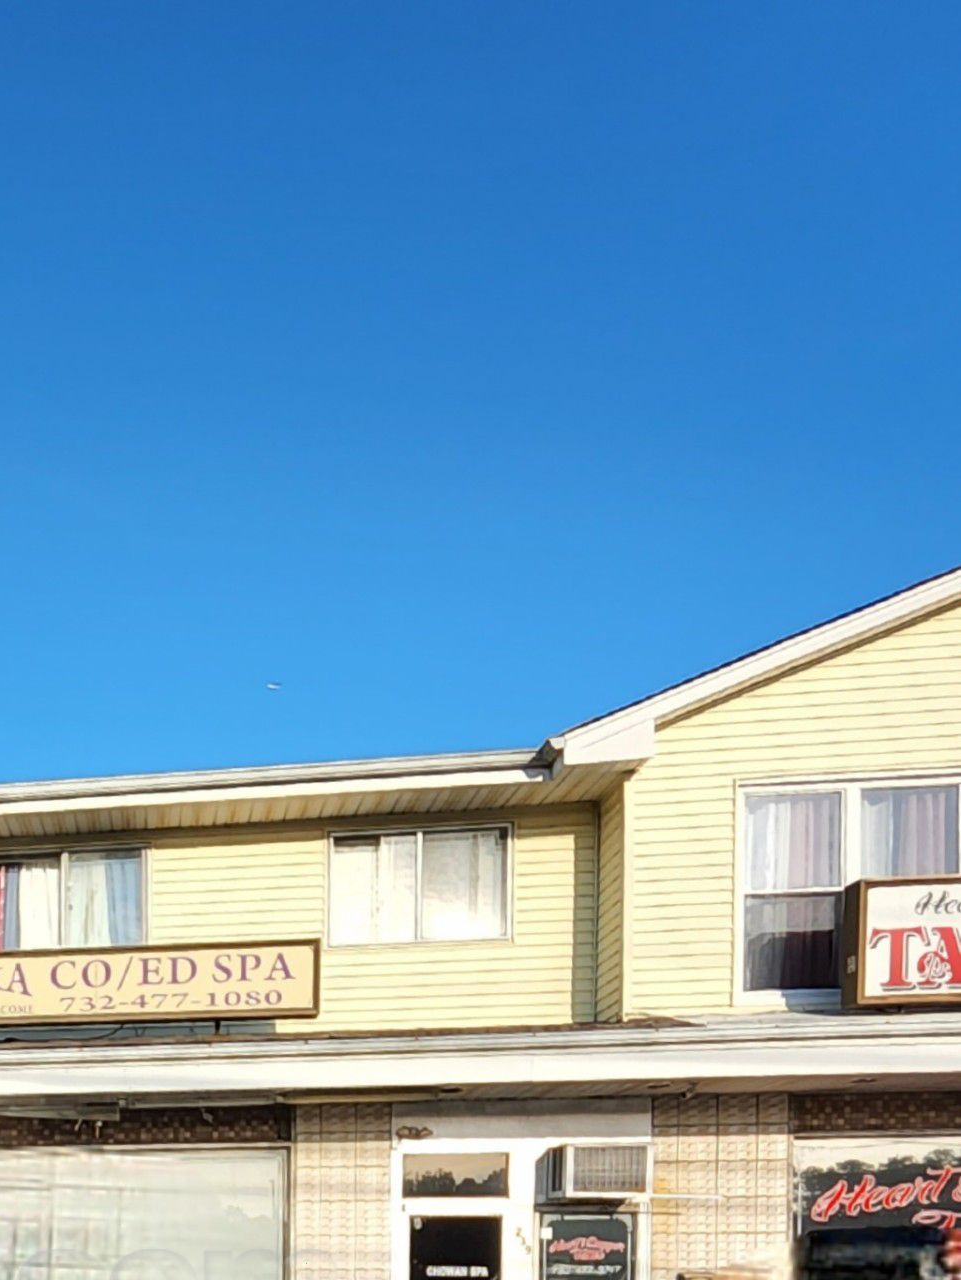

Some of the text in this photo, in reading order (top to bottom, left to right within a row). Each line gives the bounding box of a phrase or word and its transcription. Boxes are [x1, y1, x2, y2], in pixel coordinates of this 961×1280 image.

[50, 956, 198, 991] CO/ED
[212, 952, 296, 984] SPA
[59, 989, 284, 1013] 732-477-1080
[811, 1164, 961, 1222] Heart
